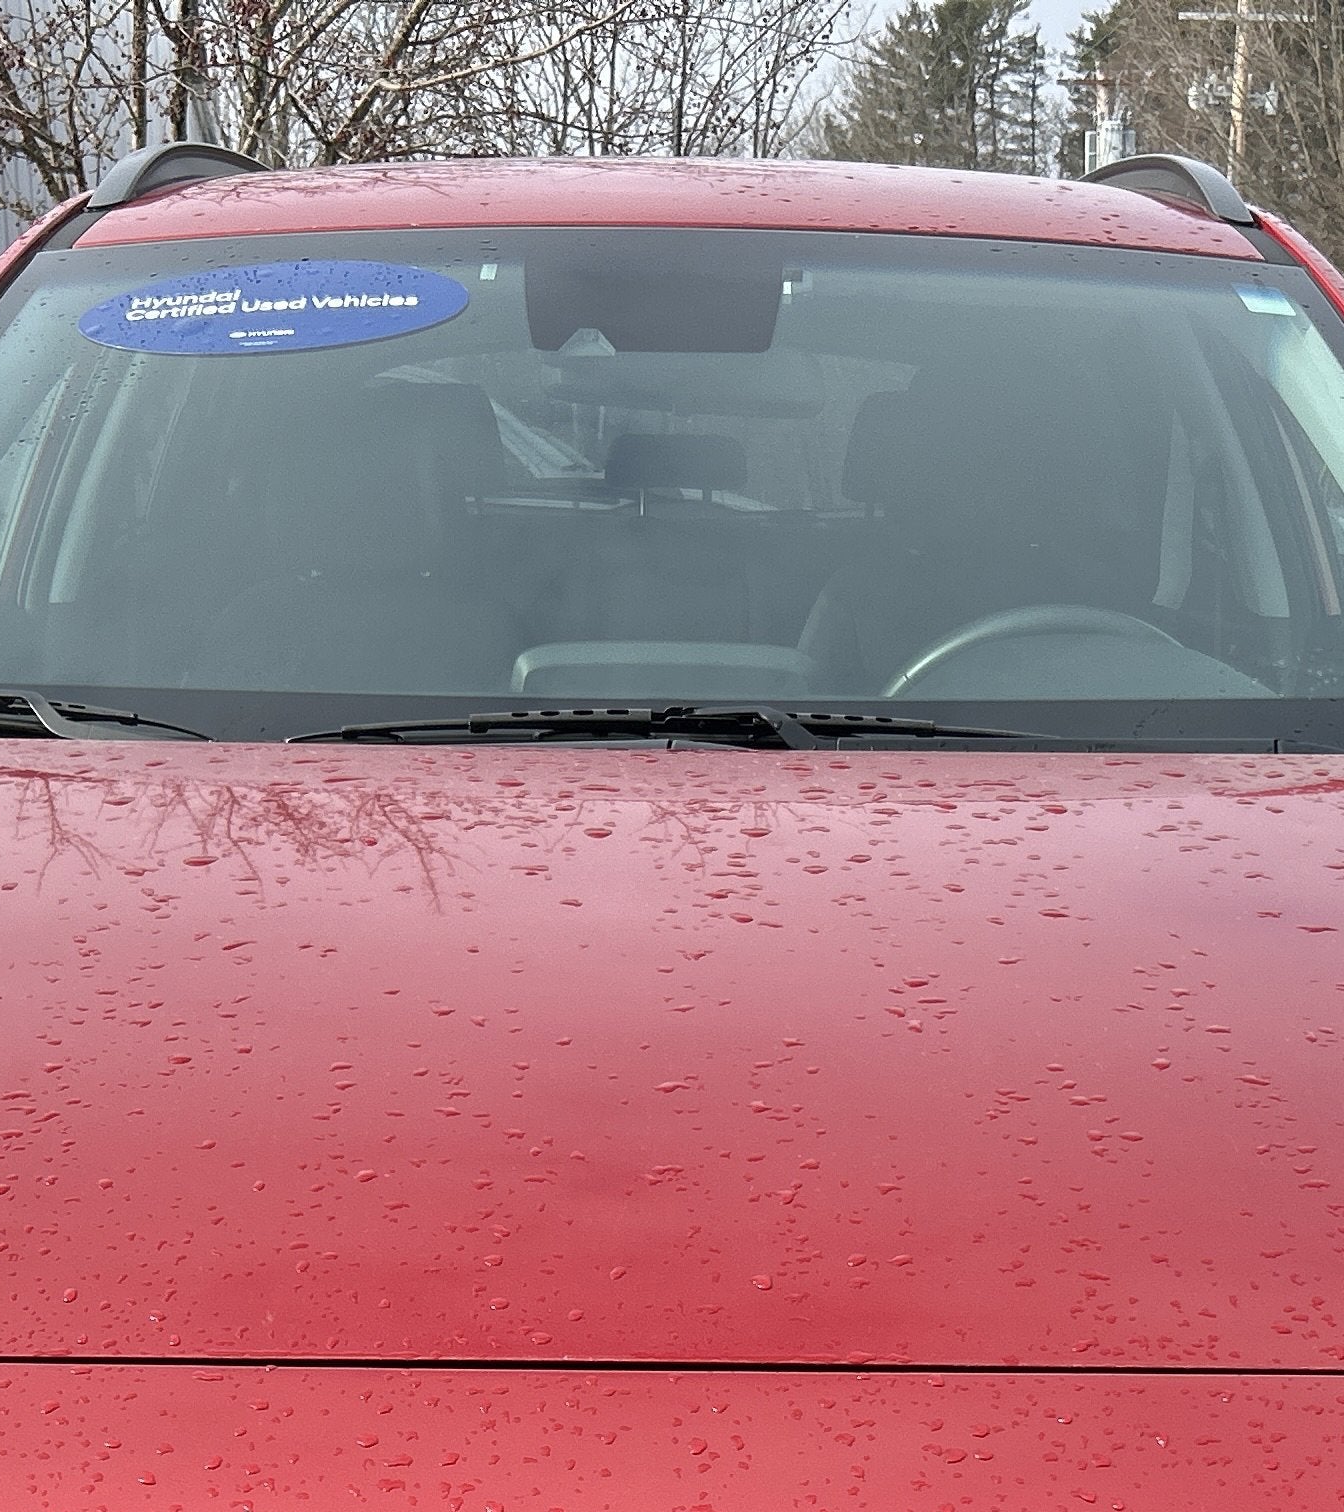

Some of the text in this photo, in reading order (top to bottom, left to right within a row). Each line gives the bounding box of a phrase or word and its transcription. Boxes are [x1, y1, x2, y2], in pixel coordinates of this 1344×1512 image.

[125, 294, 419, 321] Certified Used Vehicles
[131, 289, 241, 309] Hyundai
